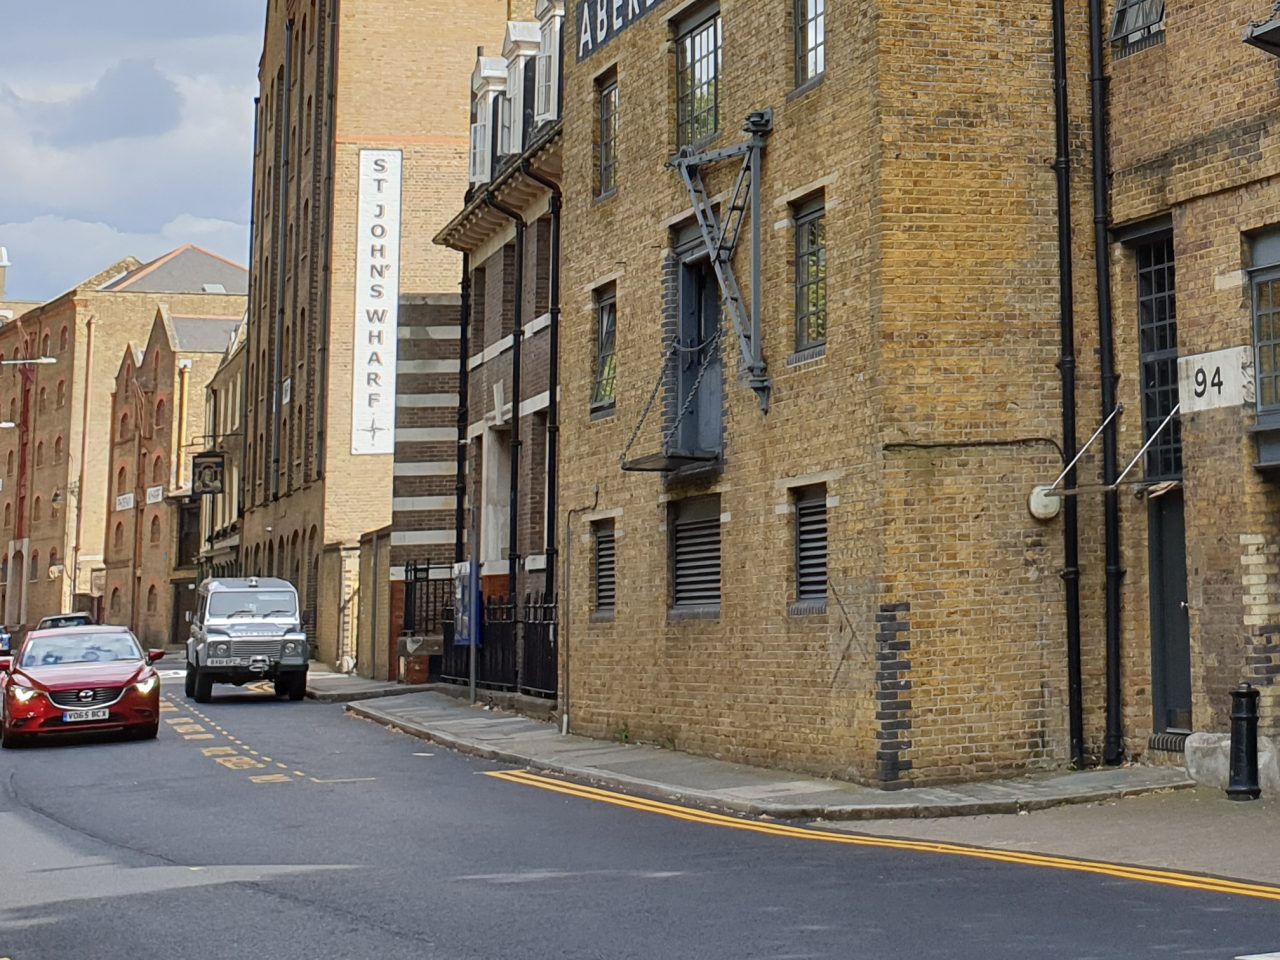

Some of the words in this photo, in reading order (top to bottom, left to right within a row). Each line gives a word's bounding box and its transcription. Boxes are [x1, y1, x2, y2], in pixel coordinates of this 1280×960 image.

[372, 158, 388, 194] ST
[365, 309, 388, 409] WHARF
[1193, 365, 1224, 399] 94
